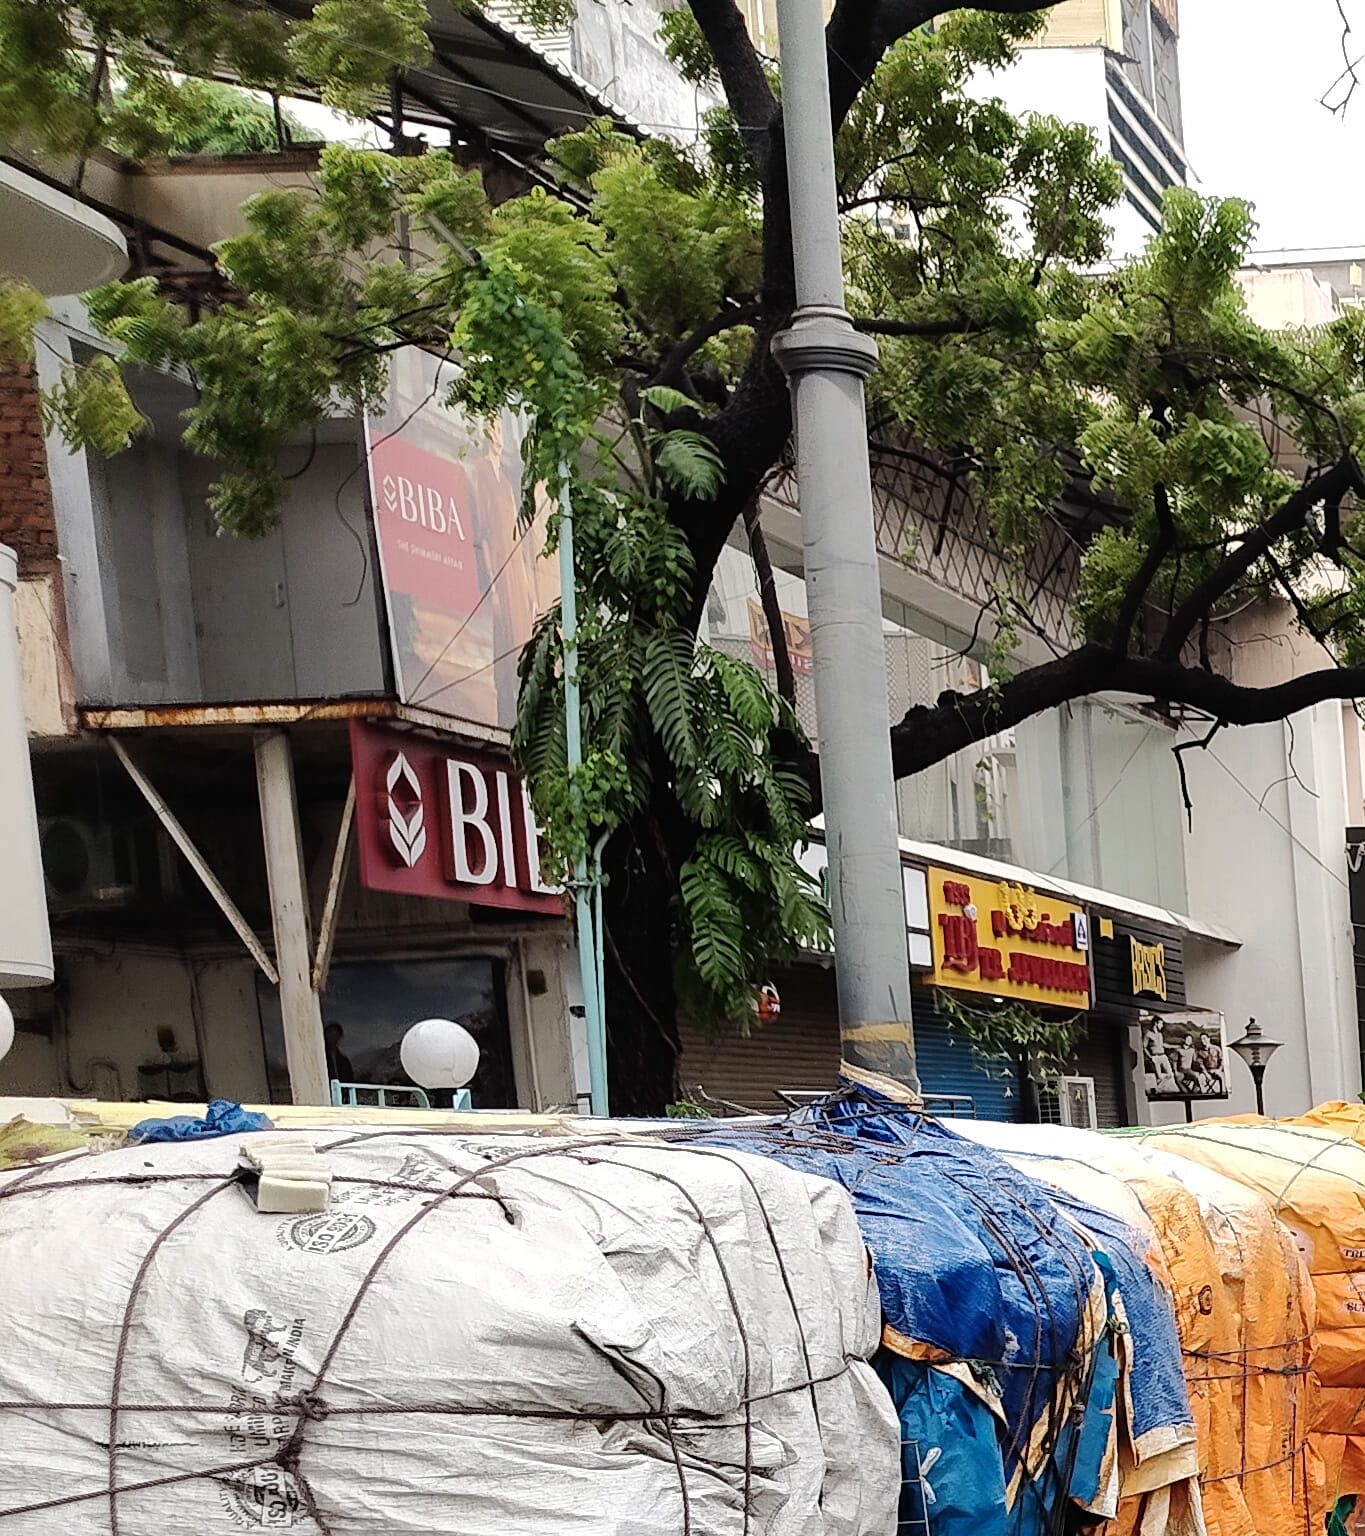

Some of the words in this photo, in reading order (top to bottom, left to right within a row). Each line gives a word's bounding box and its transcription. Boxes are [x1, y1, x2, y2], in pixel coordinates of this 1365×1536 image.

[398, 476, 465, 541] BIBA
[1131, 934, 1167, 1002] BASICS
[286, 1318, 307, 1349] INDIA
